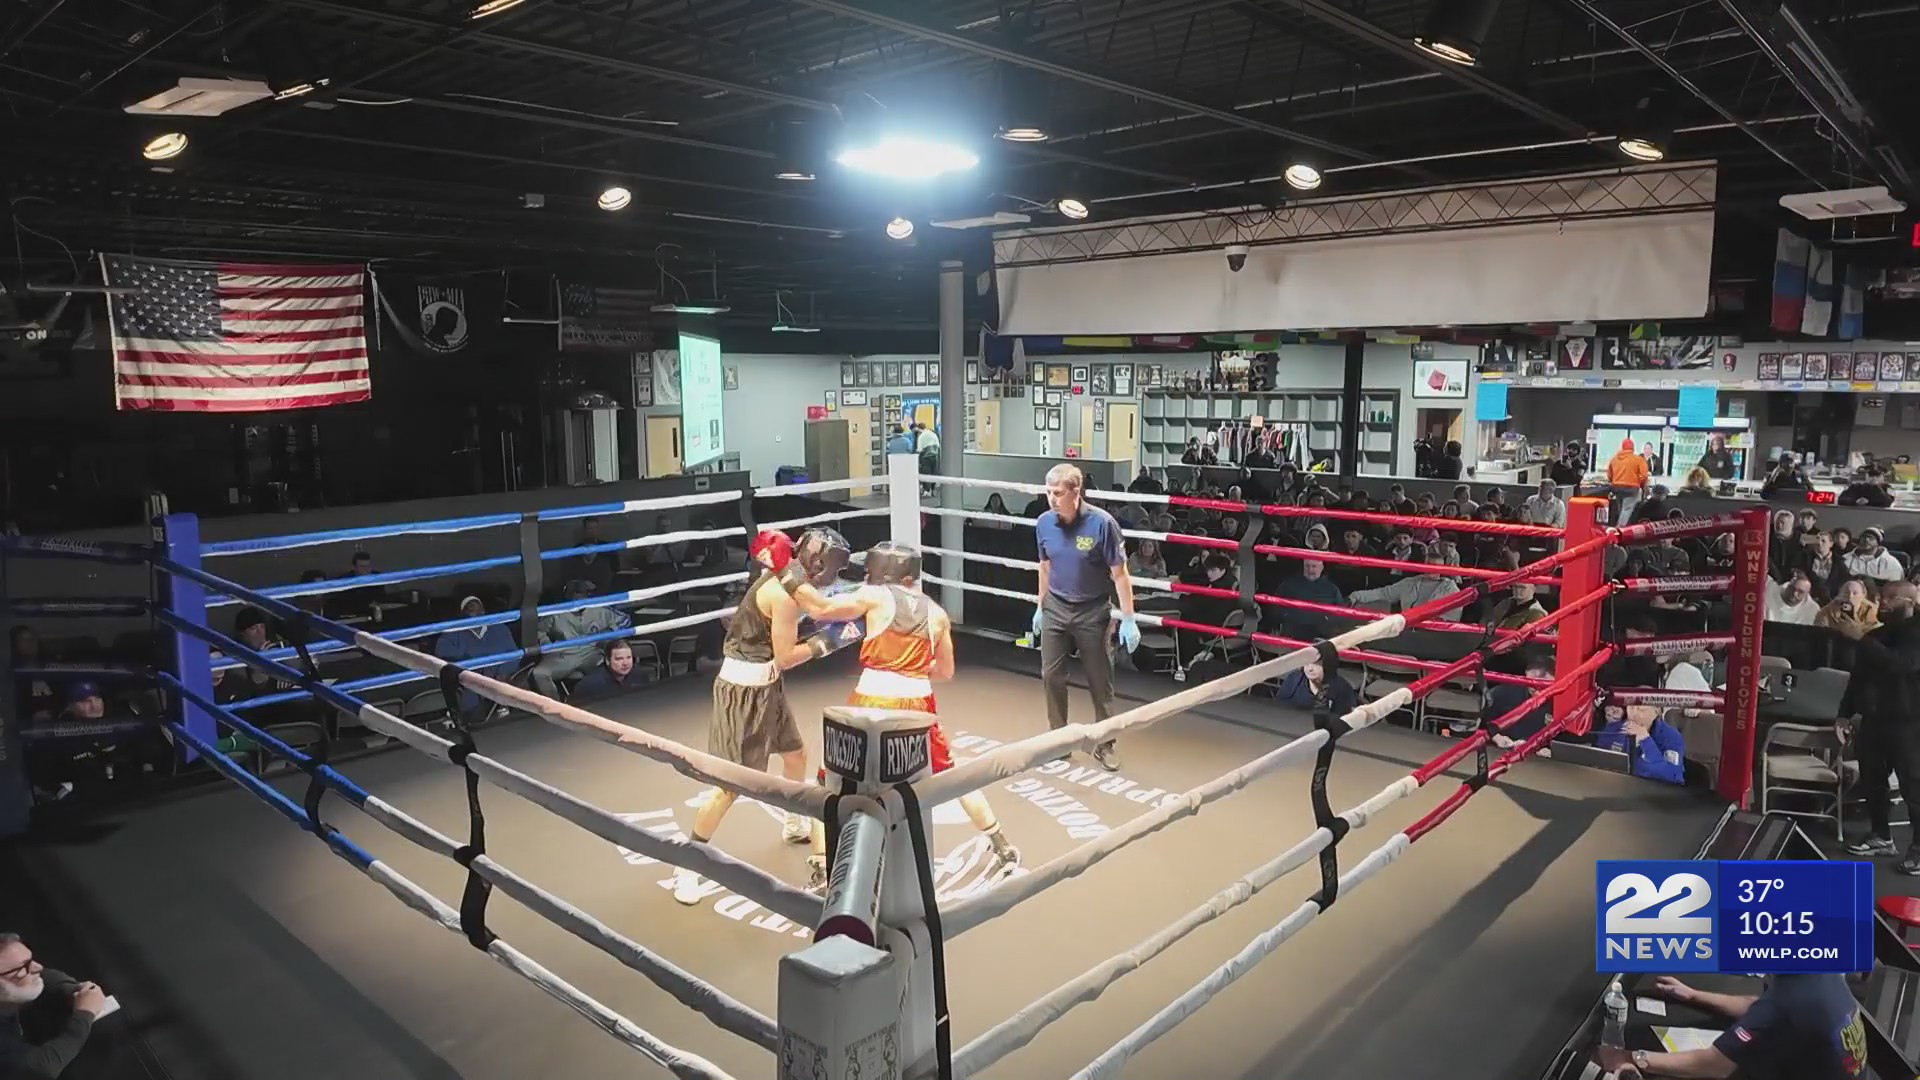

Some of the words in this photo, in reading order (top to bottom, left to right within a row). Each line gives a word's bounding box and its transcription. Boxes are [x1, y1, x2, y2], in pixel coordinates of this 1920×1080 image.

[25, 329, 48, 340] ON
[1745, 550, 1762, 584] WNE
[1739, 593, 1758, 659] GOLDEN
[1735, 665, 1752, 731] GLOVES
[1785, 675, 1793, 685] 3
[825, 725, 863, 775] RINGSIDE
[1005, 778, 1112, 840] BOXING
